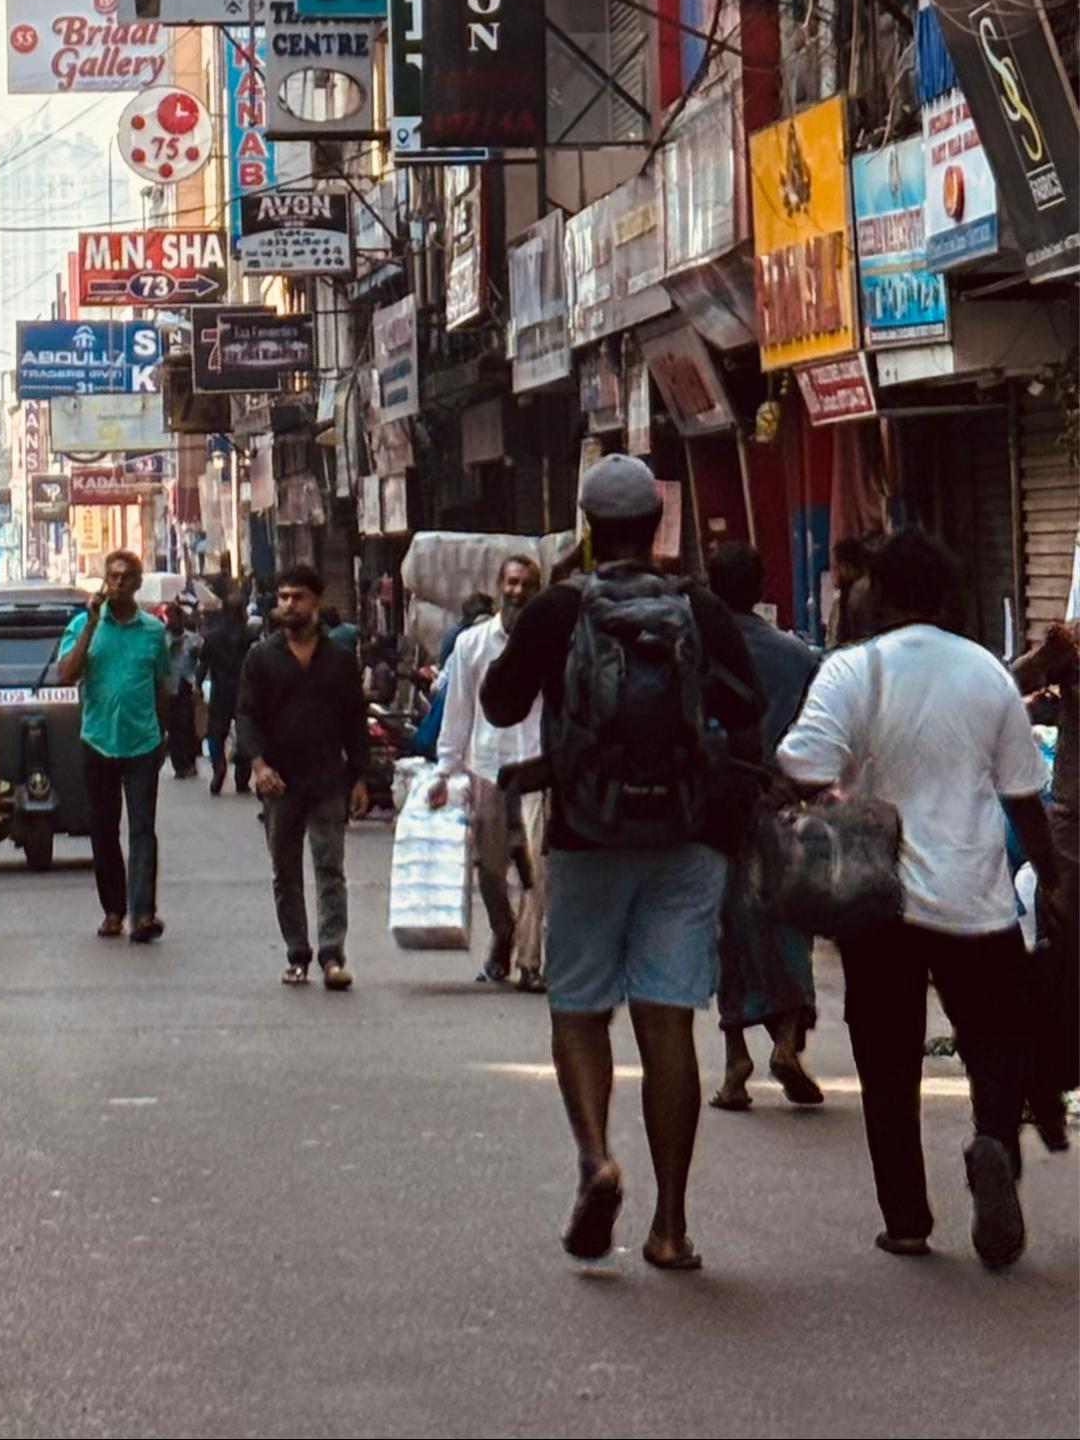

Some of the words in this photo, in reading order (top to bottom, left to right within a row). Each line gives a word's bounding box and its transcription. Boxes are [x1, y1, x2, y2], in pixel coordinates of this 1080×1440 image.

[271, 31, 370, 57] CENTRE
[50, 46, 166, 91] Gallery
[151, 137, 180, 160] 75
[256, 194, 332, 222] AVON
[84, 235, 153, 271] M.N.
[161, 233, 225, 270] SHA
[139, 276, 169, 297] 73
